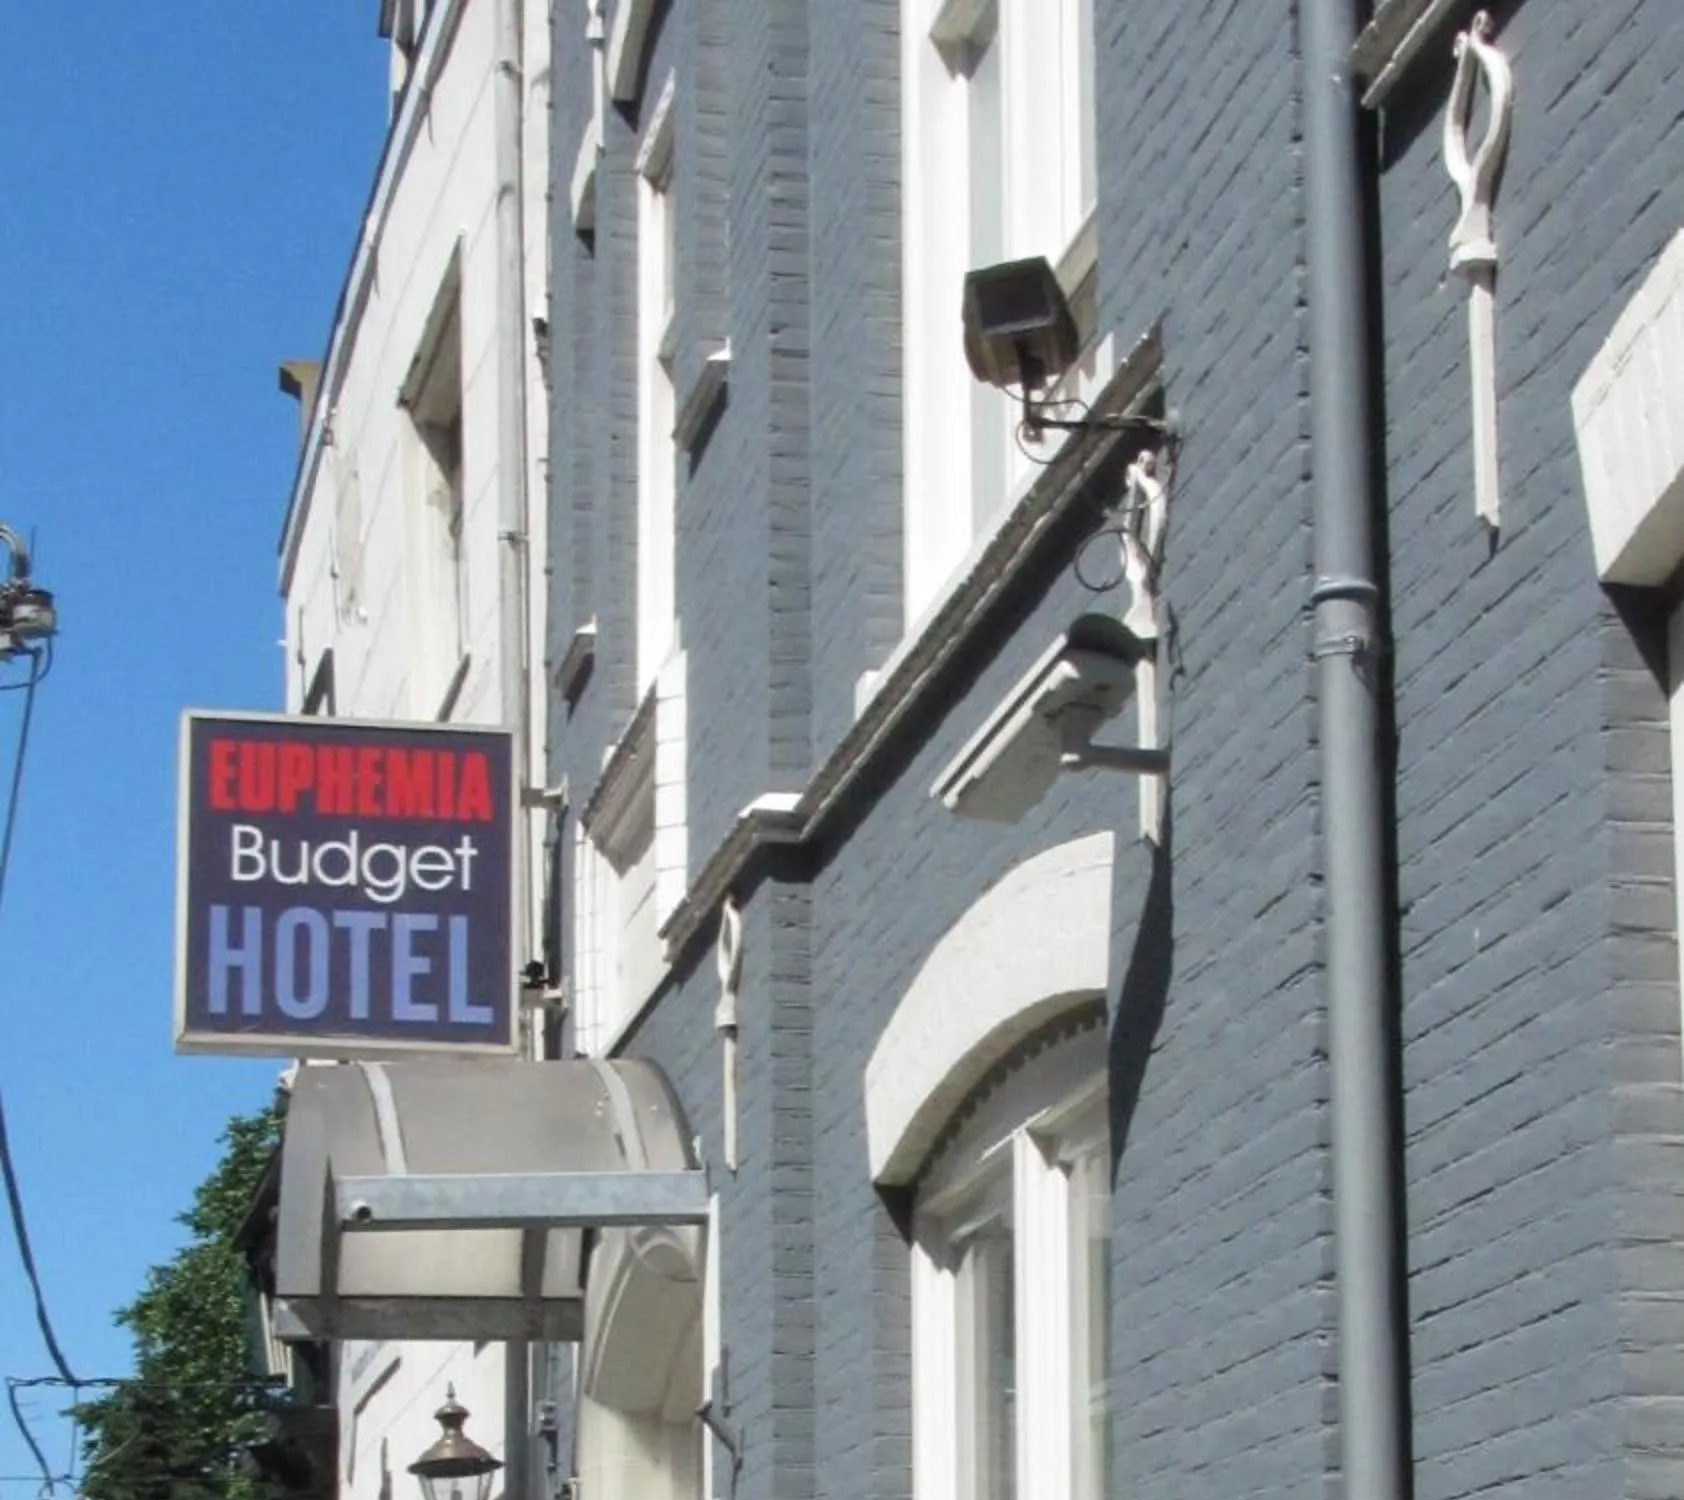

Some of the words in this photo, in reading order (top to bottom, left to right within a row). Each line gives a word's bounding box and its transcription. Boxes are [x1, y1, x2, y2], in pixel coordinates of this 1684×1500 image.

[208, 737, 495, 821] EUPHEMIA
[231, 824, 479, 903] Budget
[208, 904, 495, 1024] HOTEL
